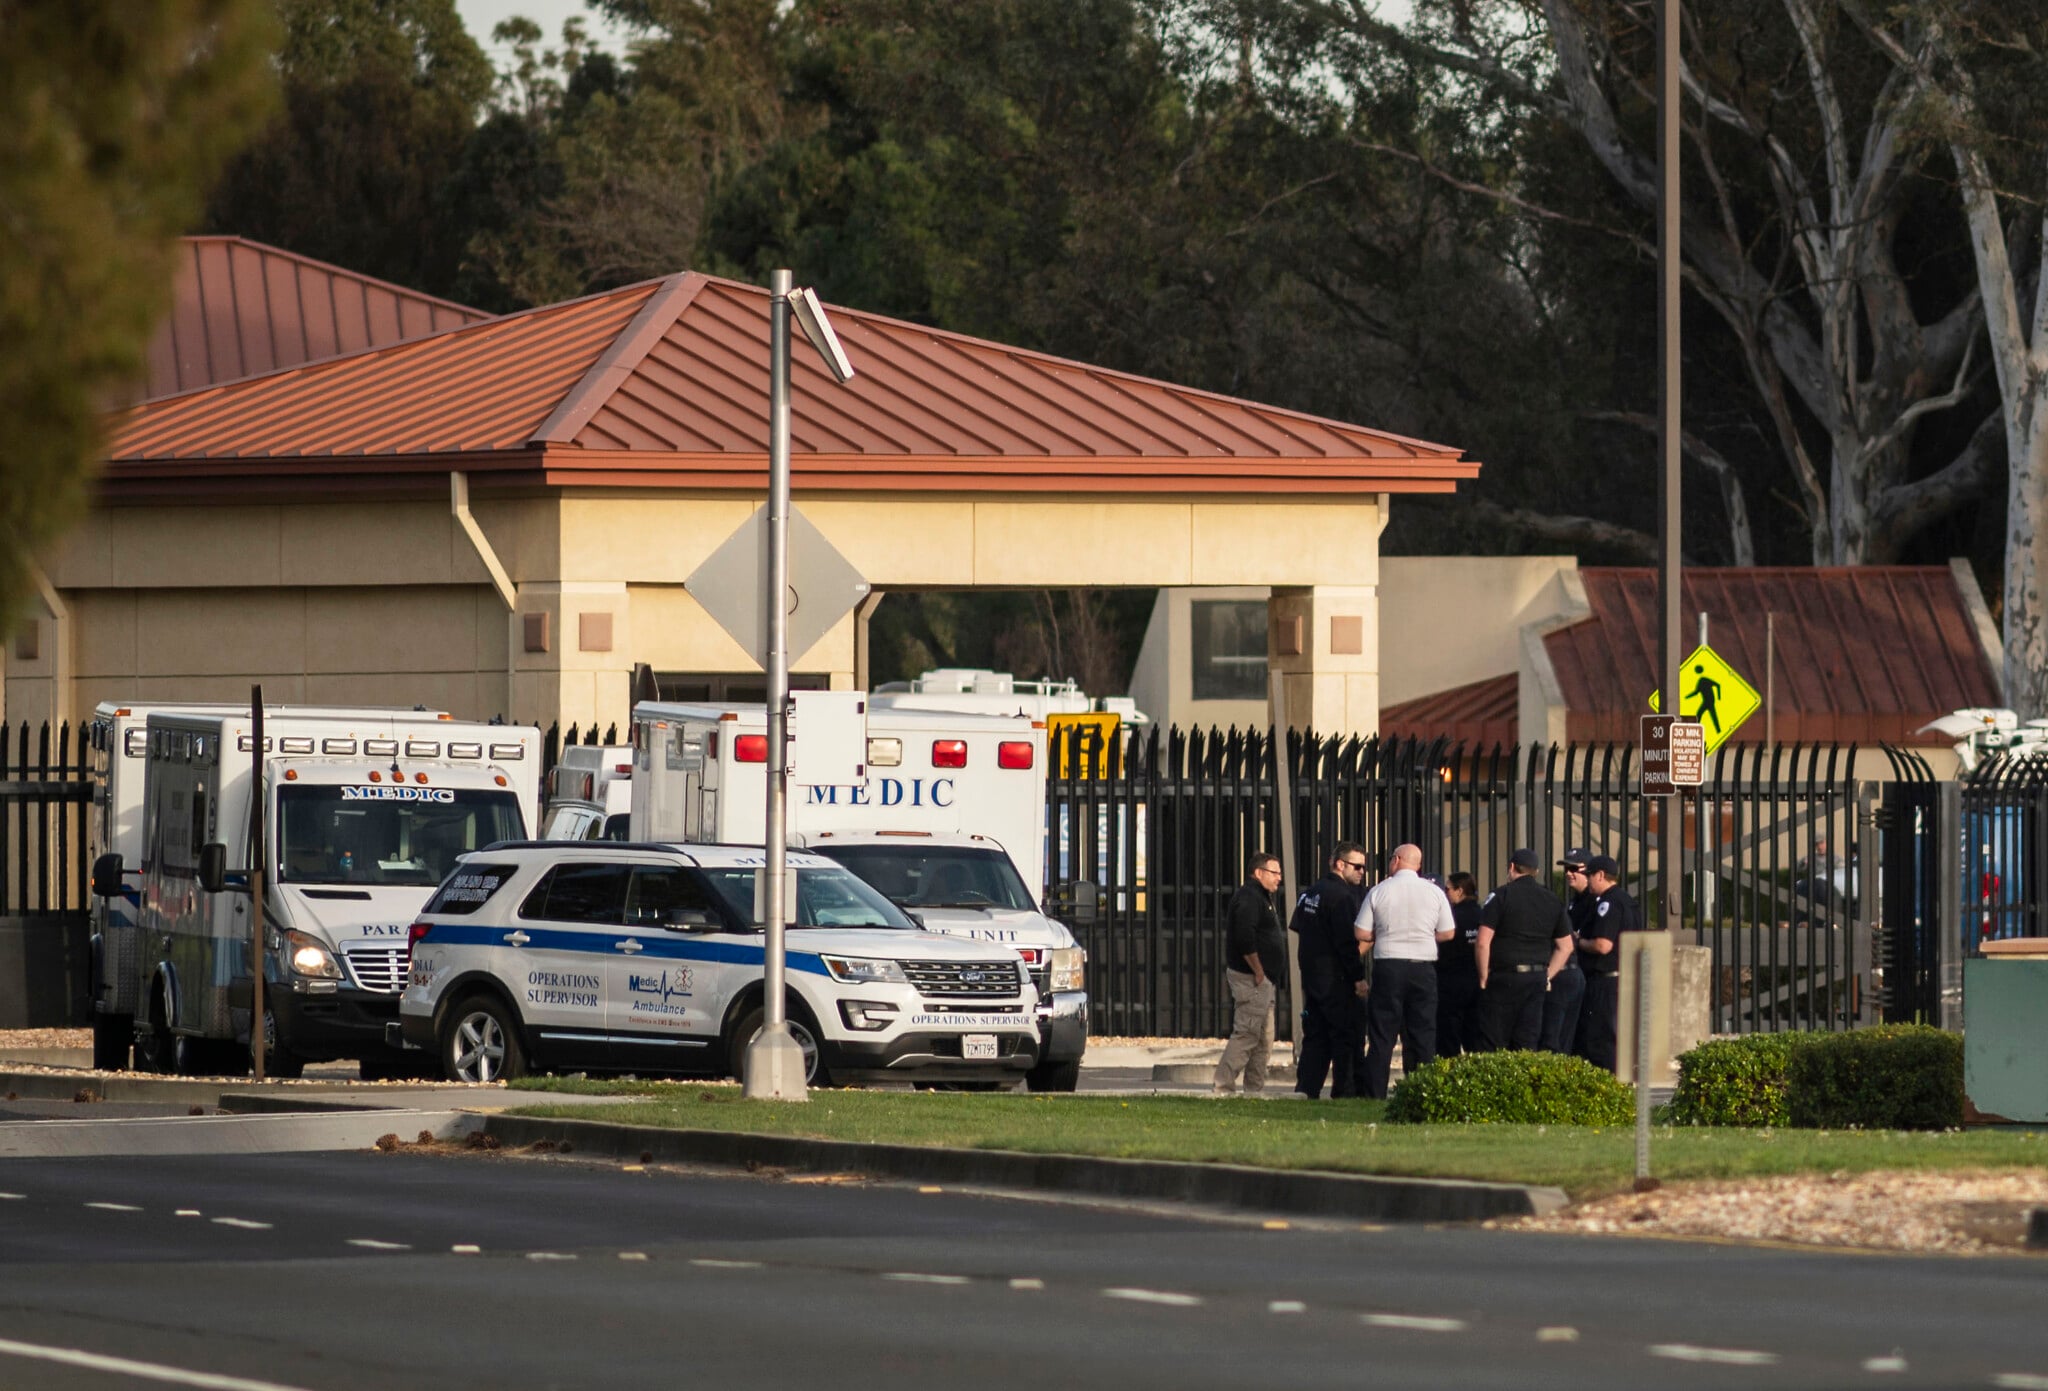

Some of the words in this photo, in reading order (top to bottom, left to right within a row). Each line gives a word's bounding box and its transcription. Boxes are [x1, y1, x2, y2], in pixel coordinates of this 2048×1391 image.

[1652, 727, 1664, 738] 30
[1674, 728, 1684, 737] 30
[1673, 738, 1701, 747] PARKING
[1644, 749, 1670, 761] MINUT
[1644, 772, 1670, 783] PARKIN
[341, 786, 455, 803] MEDIC
[806, 778, 954, 807] MEDIC
[970, 930, 1017, 941] UNIT
[414, 960, 434, 971] DIAL
[528, 971, 600, 989] OPERATIONS
[629, 975, 658, 991] Medic
[527, 989, 598, 1007] SUPERVISOR
[633, 1000, 686, 1015] Ambulance
[911, 1015, 977, 1025] OPERATIONS
[980, 1015, 1030, 1025] SUPERVISOR
